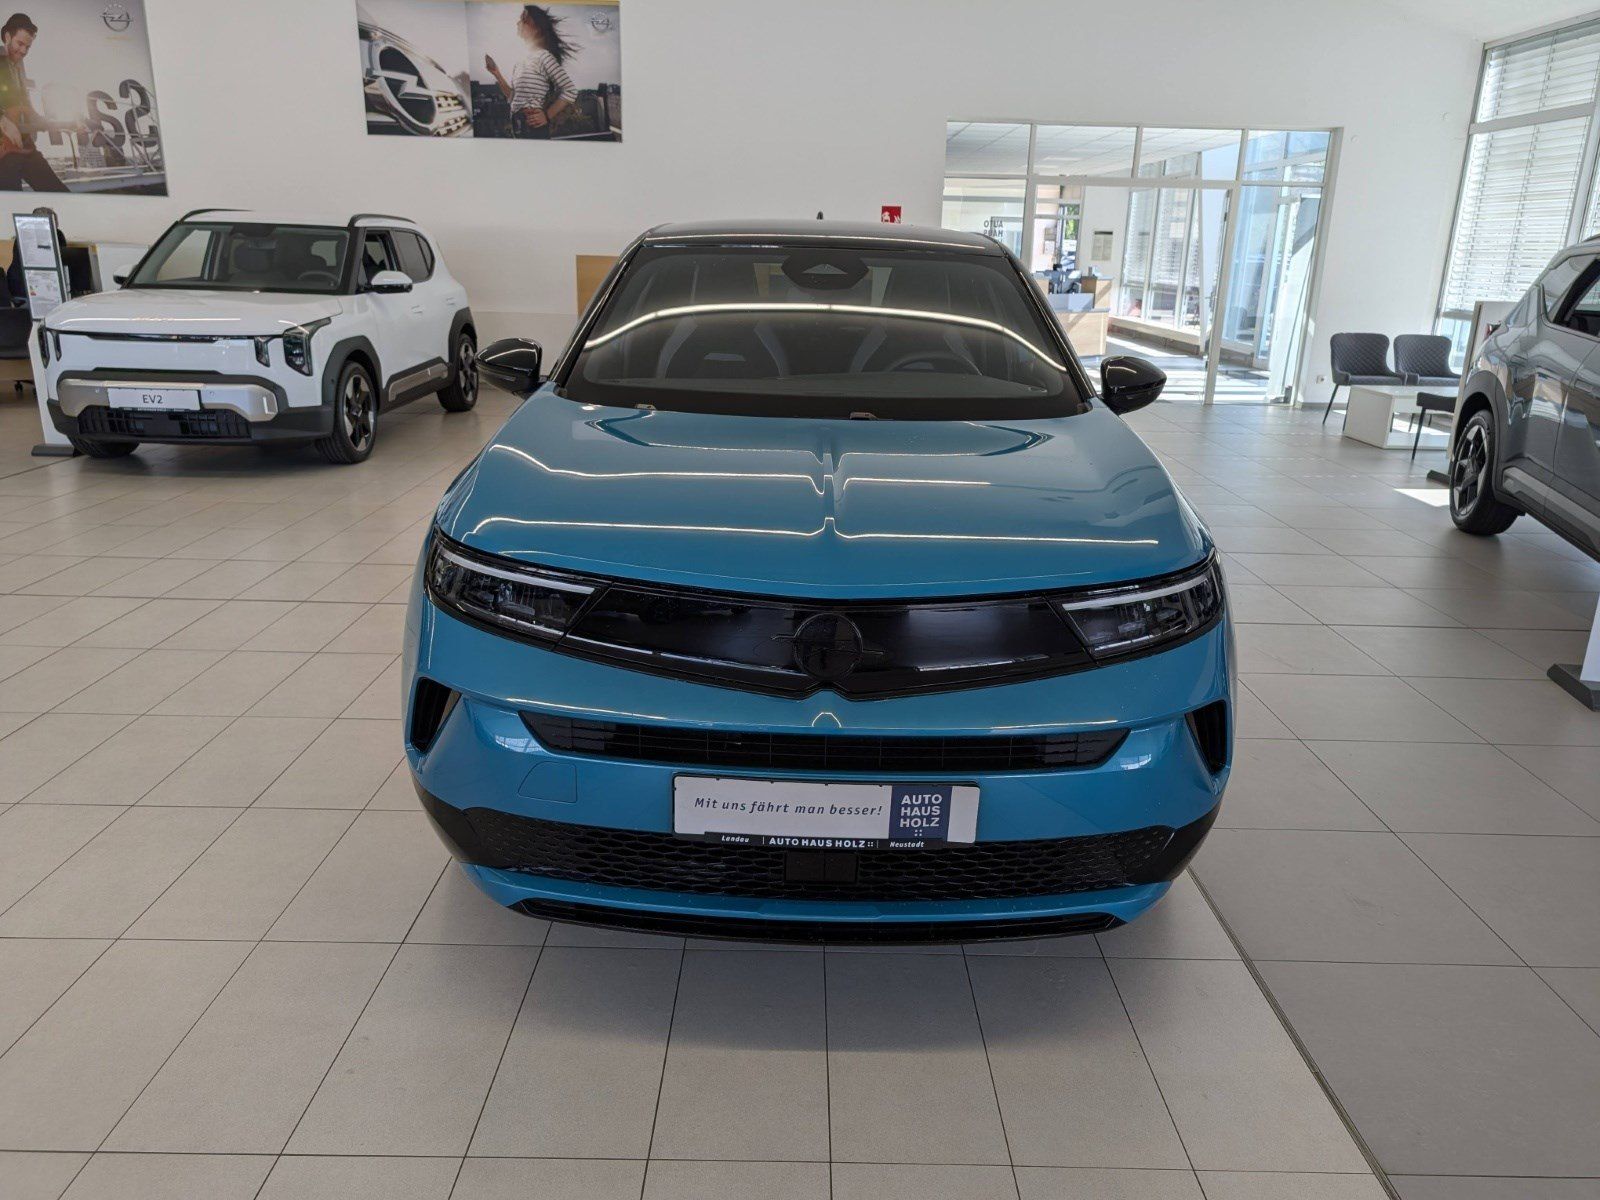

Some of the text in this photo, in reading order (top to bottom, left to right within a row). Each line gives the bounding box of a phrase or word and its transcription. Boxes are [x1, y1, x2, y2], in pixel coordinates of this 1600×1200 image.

[142, 394, 164, 404] EV2
[901, 793, 943, 805] AUTO
[694, 797, 883, 815] Mit uns fährt man besser!
[900, 805, 941, 816] HAUS
[899, 817, 940, 828] HOLZ
[769, 837, 799, 846] AUTO
[801, 838, 833, 847] HAUS
[835, 840, 865, 848] HOLZ
[889, 840, 925, 848] Neustadt
